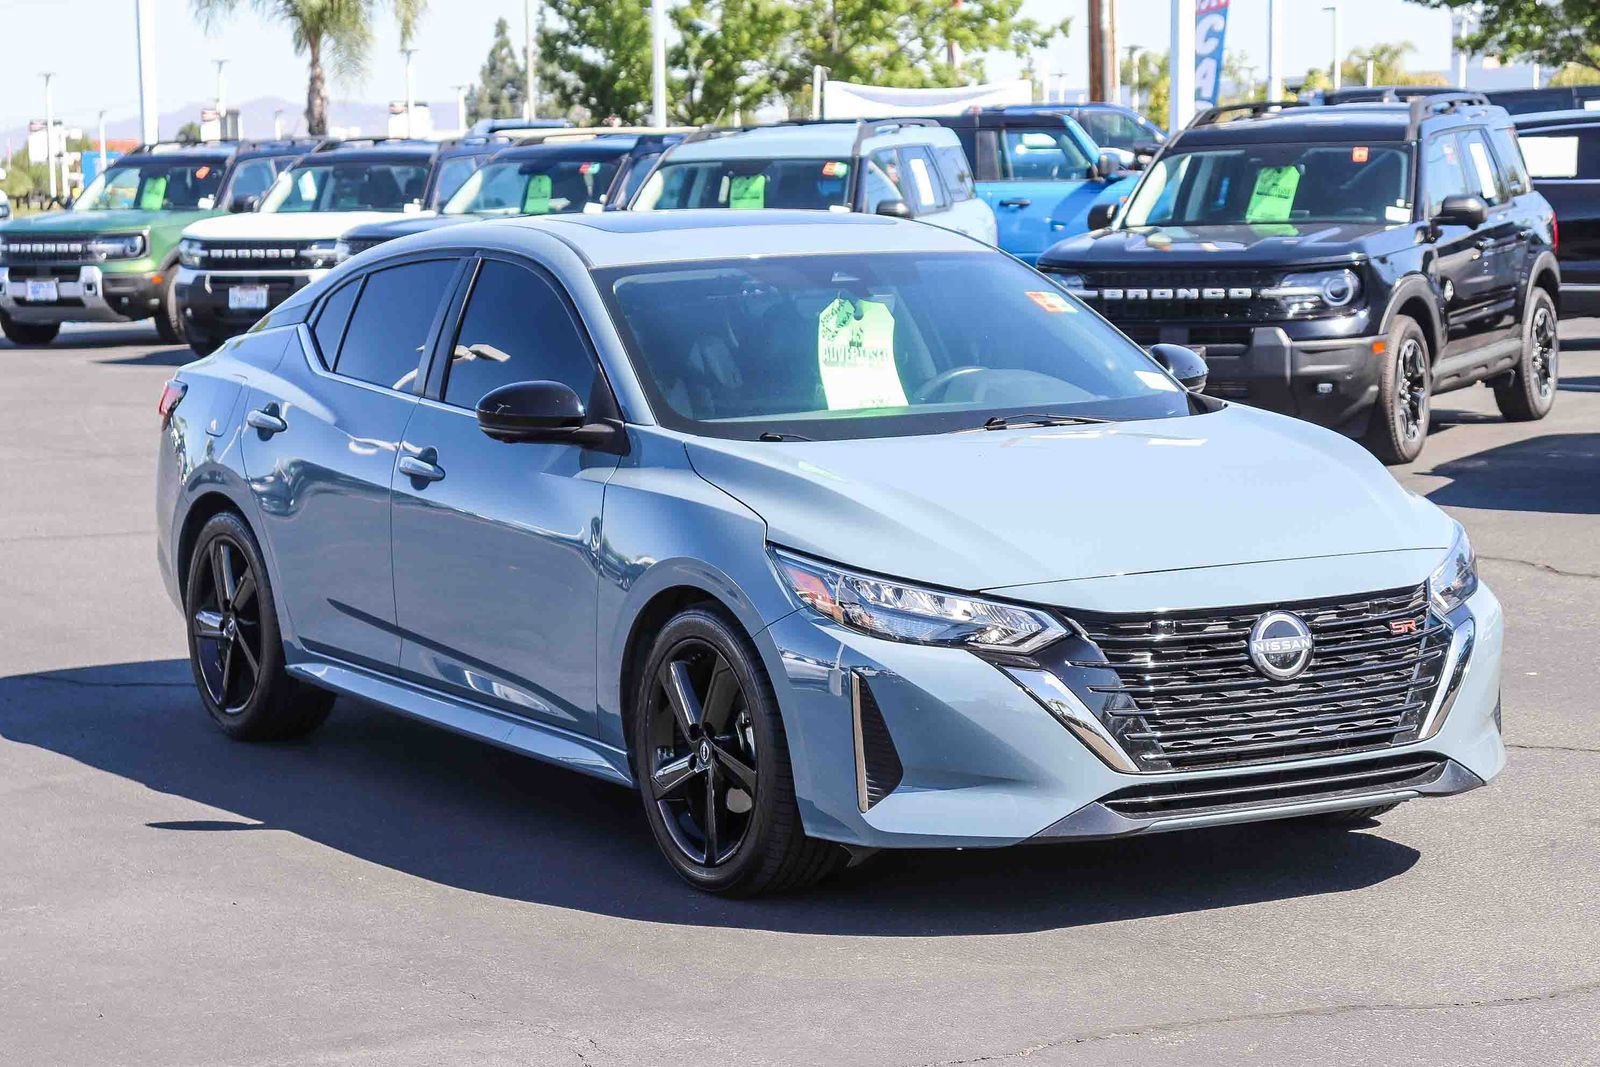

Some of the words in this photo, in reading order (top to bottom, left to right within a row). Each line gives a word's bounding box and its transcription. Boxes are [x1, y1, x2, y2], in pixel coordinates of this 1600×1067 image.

[1102, 287, 1253, 300] BRONCO
[1390, 619, 1418, 635] SR
[1253, 638, 1311, 652] NISSAN
